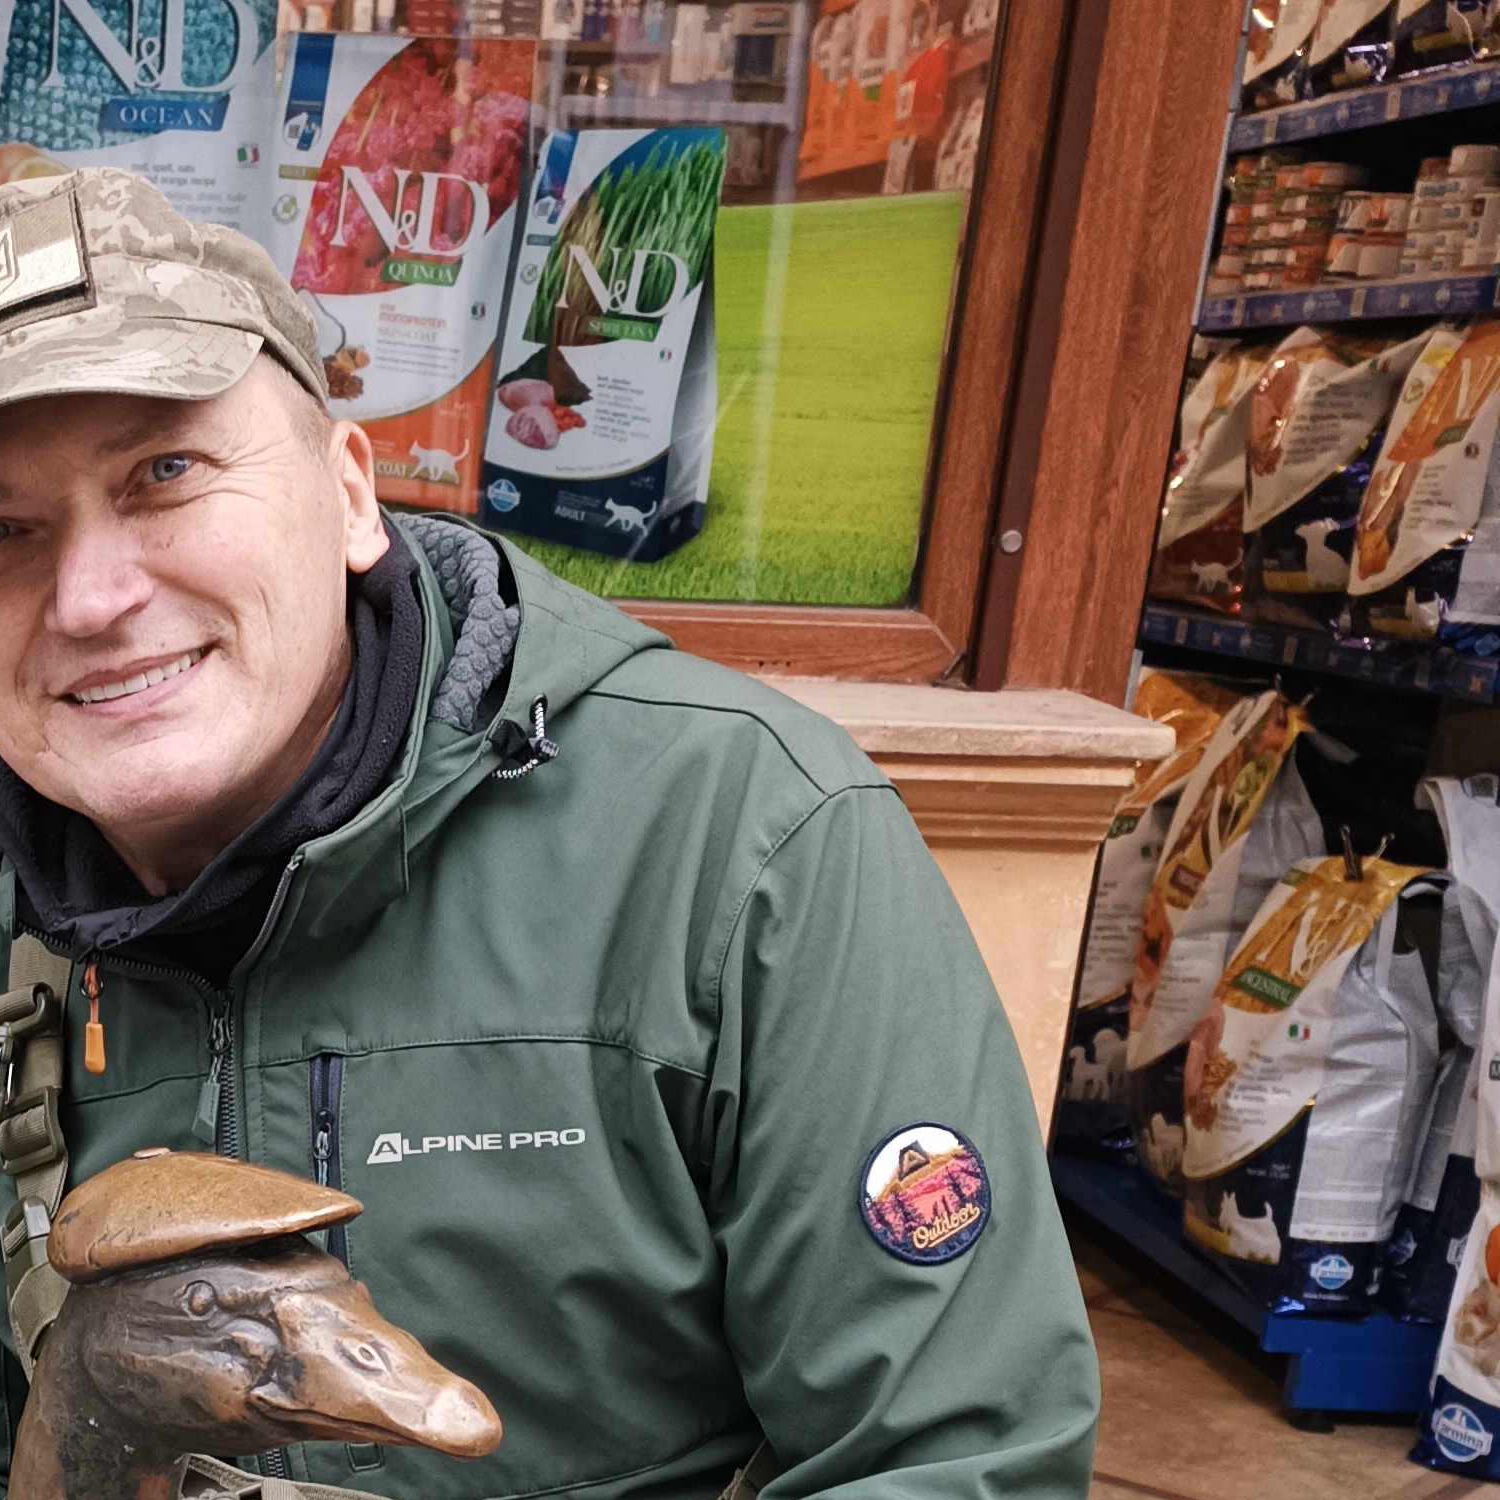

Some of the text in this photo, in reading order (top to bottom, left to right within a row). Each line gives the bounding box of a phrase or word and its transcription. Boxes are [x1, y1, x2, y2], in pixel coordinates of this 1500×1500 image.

[41, 0, 259, 93] N&D
[119, 105, 214, 127] OCEAN
[329, 164, 490, 257] N&D
[388, 261, 455, 284] QUINOA
[555, 244, 690, 318] N&D
[367, 1128, 587, 1165] ALPINE PRO
[913, 1202, 980, 1249] Outdoor
